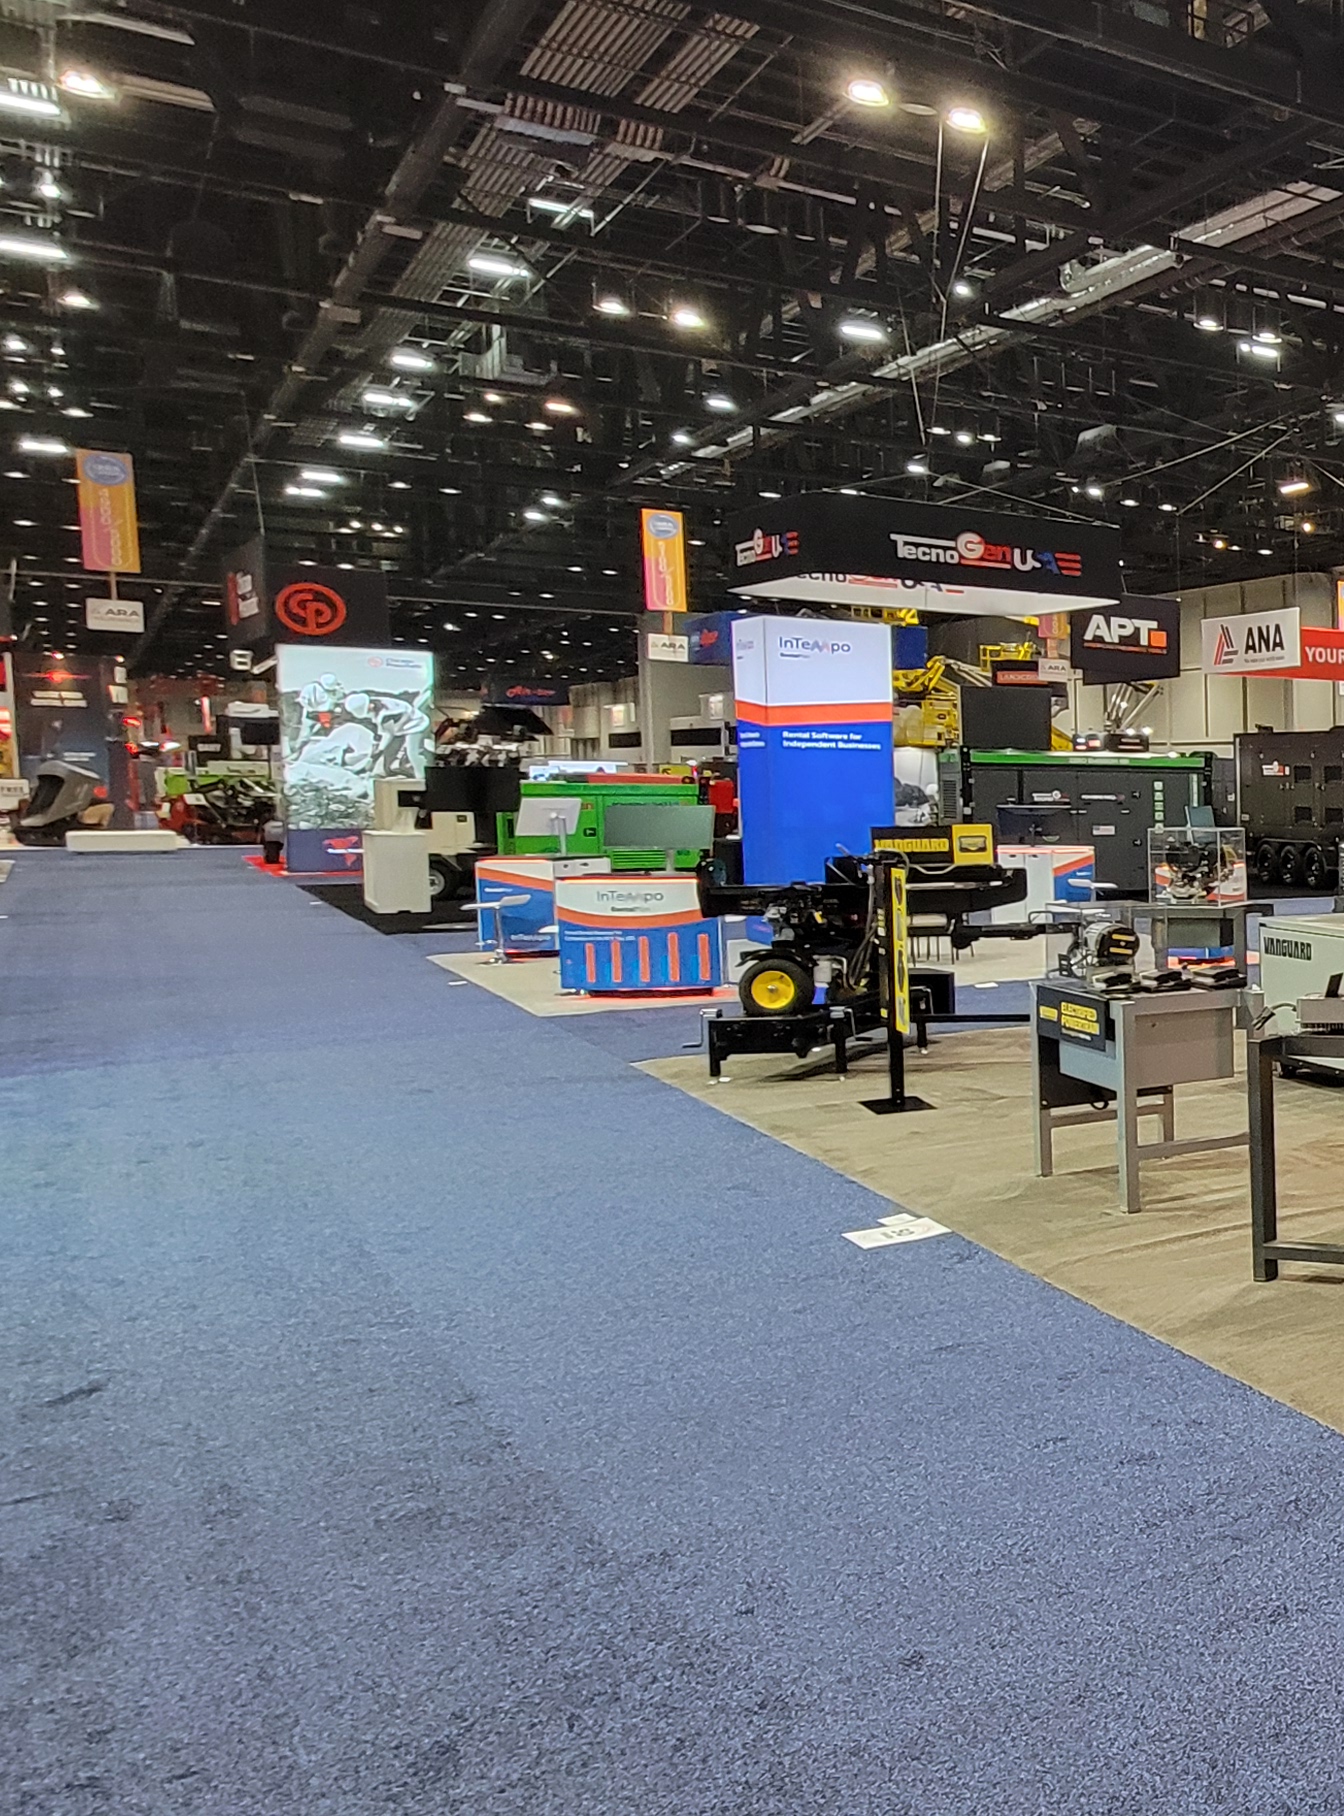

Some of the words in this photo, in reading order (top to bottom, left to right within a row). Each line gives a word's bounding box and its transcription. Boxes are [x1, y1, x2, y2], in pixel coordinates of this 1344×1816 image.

[890, 531, 1012, 569] TecnoGen
[1244, 623, 1285, 655] ANA
[1263, 936, 1312, 961] VANGUARD
